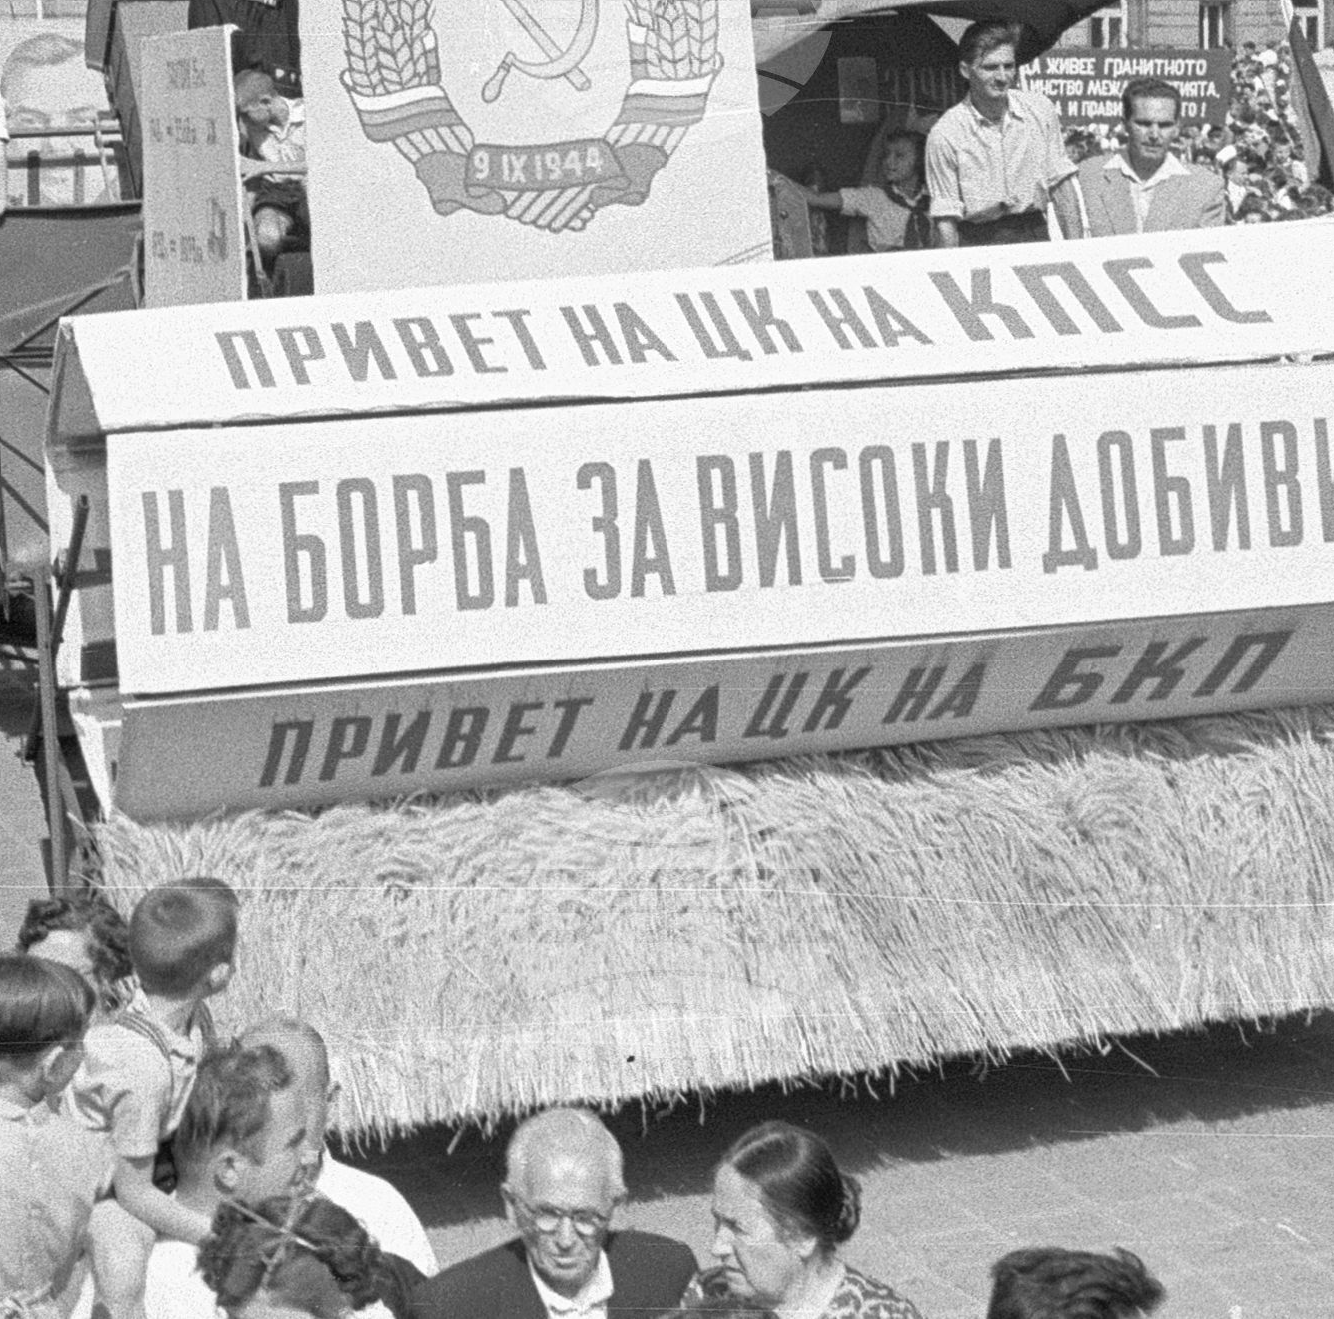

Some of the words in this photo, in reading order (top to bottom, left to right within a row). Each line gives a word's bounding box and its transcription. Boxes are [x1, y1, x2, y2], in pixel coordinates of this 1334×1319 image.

[1046, 57, 1097, 76] ЖИВЕЕ
[1104, 57, 1208, 78] ГРАНИТНОТО
[1068, 101, 1079, 117] И
[473, 150, 490, 180] 9
[534, 146, 605, 181] 1944
[213, 309, 548, 390] ПРИВЕТ
[558, 302, 680, 367] НА
[673, 286, 805, 363] ЦК
[805, 285, 936, 350] НА
[926, 251, 1275, 342] КПСС
[140, 485, 253, 636] НА
[278, 467, 549, 624] БОРБА
[575, 458, 678, 602] ЗА
[695, 436, 1013, 593] ВИСОКИ
[259, 696, 595, 787] ПРИВЕТ
[618, 682, 720, 752] НА
[741, 666, 872, 740] ЦК
[881, 660, 989, 724] НА
[1027, 630, 1296, 712] БКП
